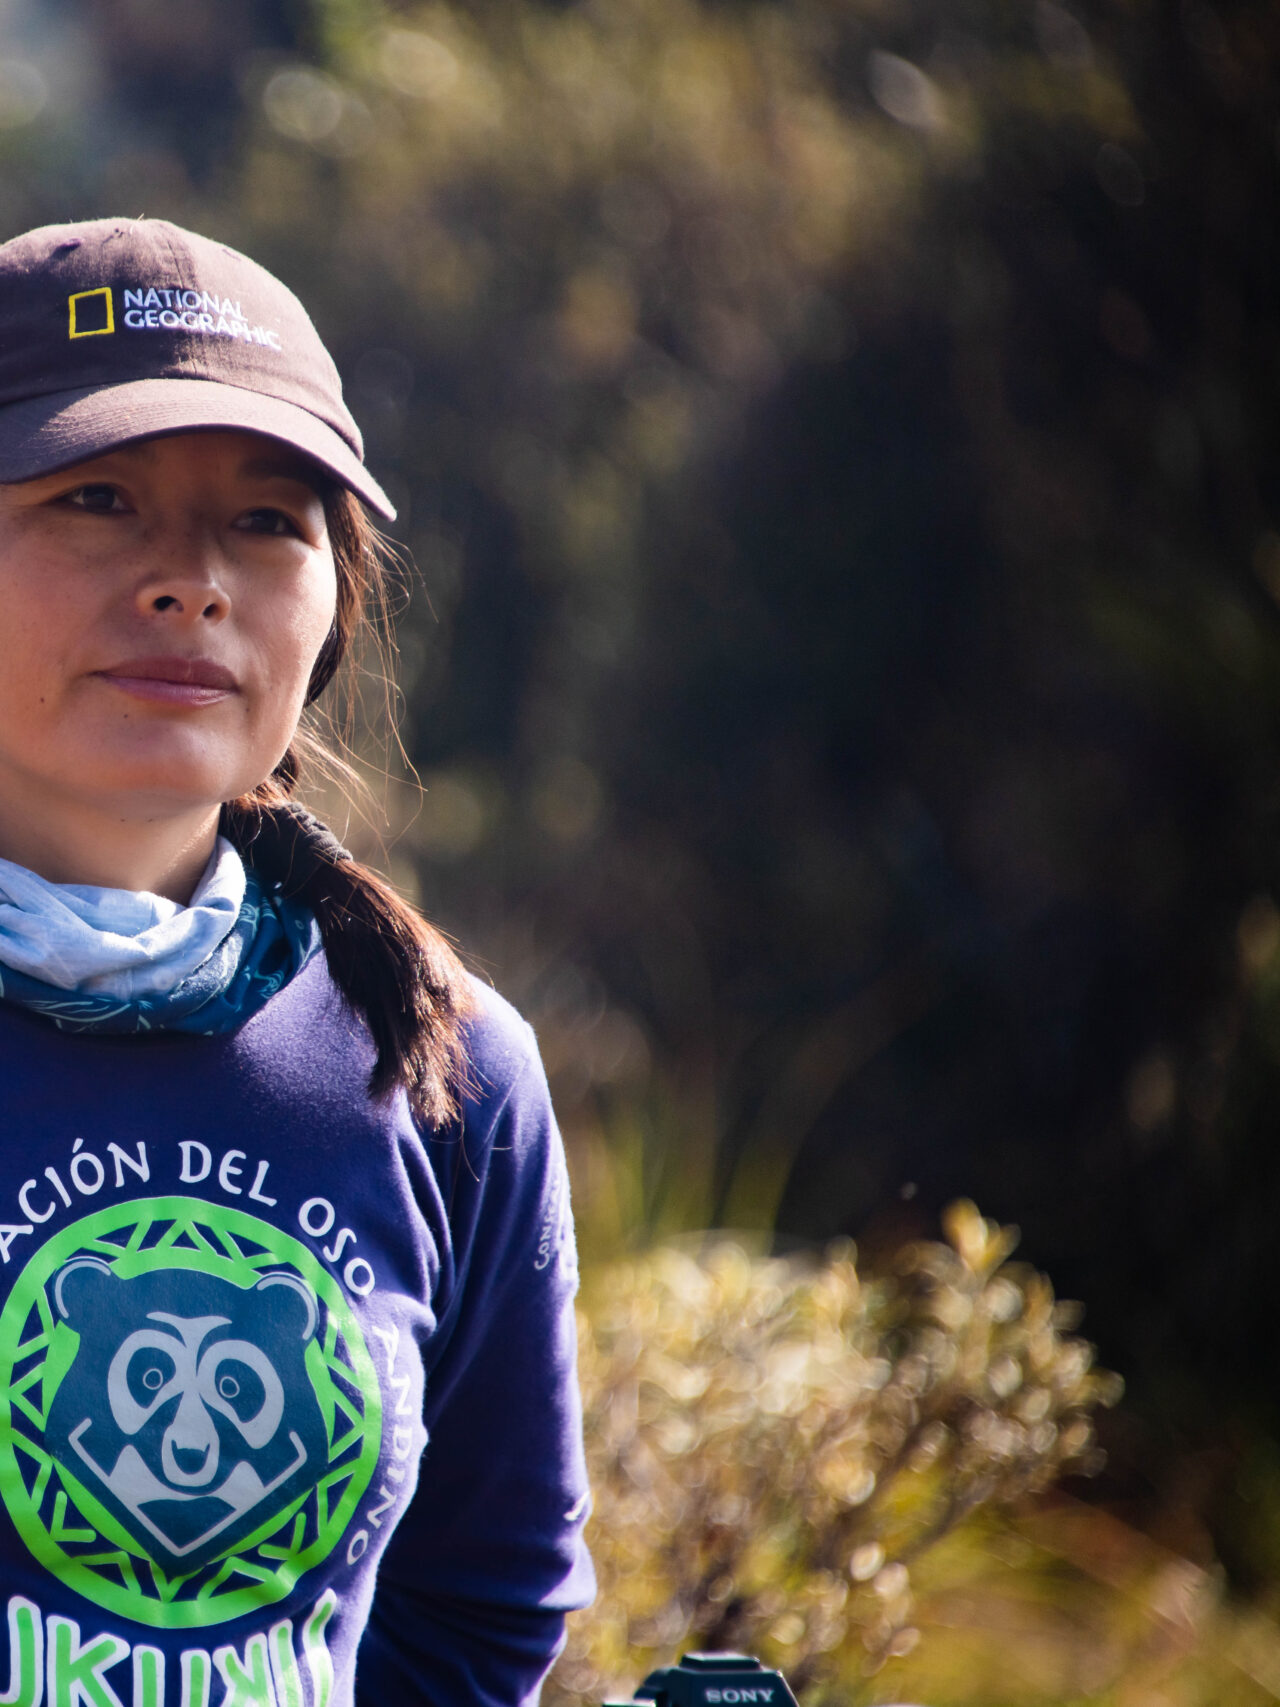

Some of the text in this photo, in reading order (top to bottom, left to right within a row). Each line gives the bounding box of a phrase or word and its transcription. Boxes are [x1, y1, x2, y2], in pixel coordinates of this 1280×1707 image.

[123, 287, 248, 321] NATIONAL
[123, 309, 283, 350] GEOGRAPHIC
[178, 1140, 277, 1206] DEL
[298, 1198, 376, 1296] OSO
[346, 1323, 414, 1566] ANDINO
[706, 1689, 775, 1703] SONY
